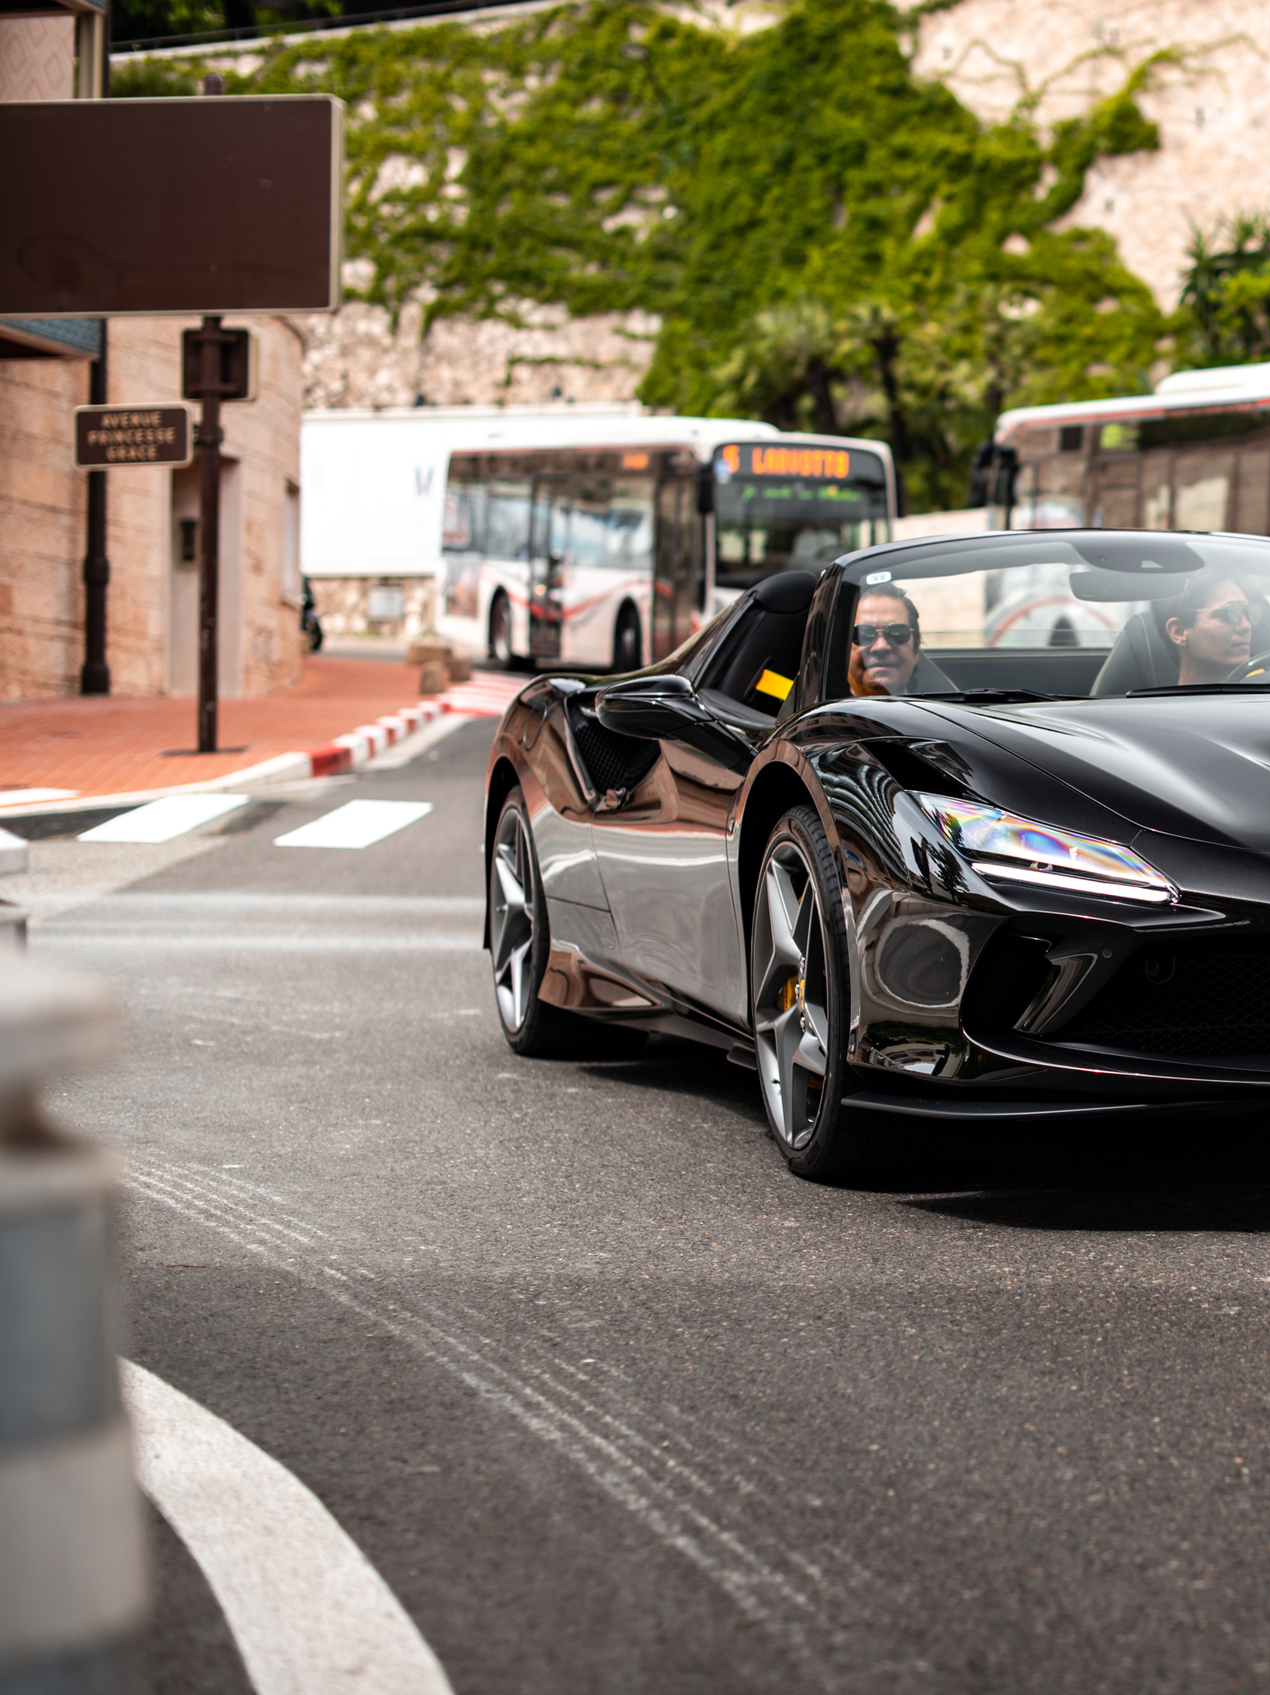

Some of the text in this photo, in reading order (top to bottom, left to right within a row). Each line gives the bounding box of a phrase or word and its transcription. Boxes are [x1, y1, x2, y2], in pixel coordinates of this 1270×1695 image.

[101, 411, 162, 429] AVENUE
[87, 427, 176, 446] PRINCESSE
[106, 444, 158, 462] GRACE
[752, 447, 849, 478] LARVOTTO
